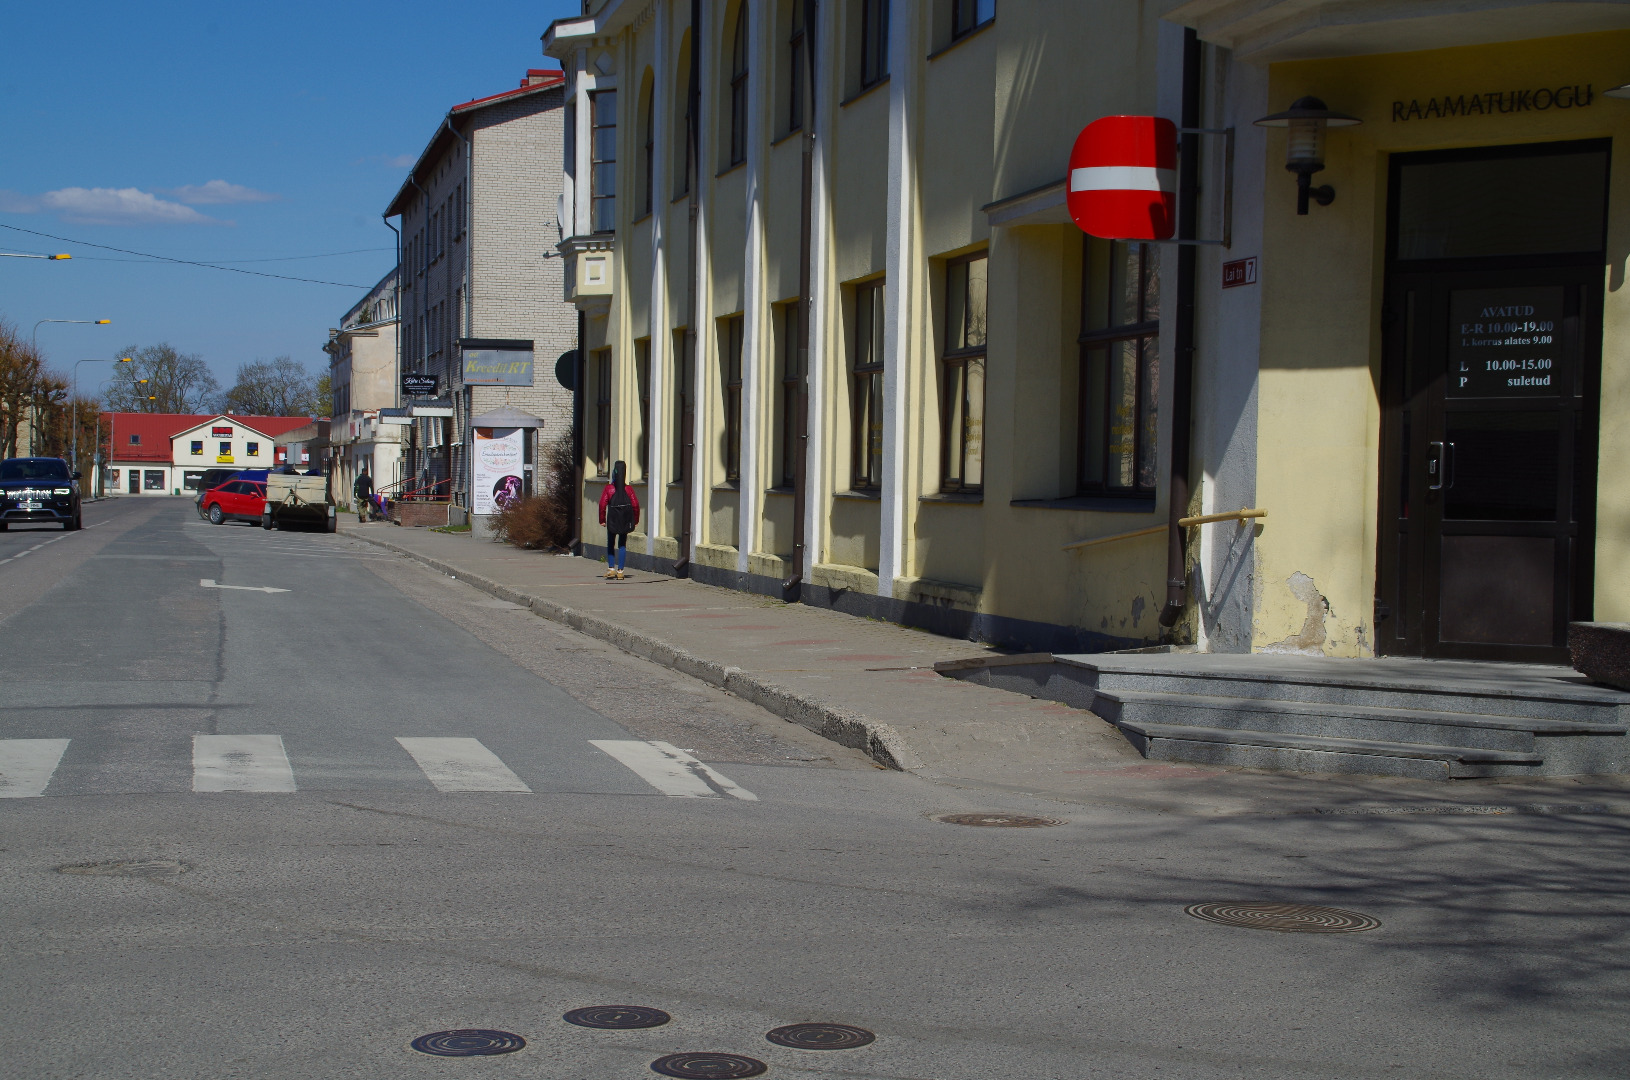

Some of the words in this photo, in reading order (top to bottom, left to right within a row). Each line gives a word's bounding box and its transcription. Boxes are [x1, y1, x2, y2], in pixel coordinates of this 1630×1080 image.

[1391, 84, 1594, 123] RAAMATUKOGU
[1225, 267, 1235, 282] Lai
[1236, 267, 1243, 280] tn
[1247, 261, 1254, 281] 7
[1480, 305, 1535, 318] AVATUD
[1461, 323, 1484, 335] E-R
[1487, 320, 1554, 334] 10.00-19.00
[1472, 338, 1502, 347] korrus
[1504, 336, 1531, 346] alates
[1532, 335, 1553, 345] 9.00
[1460, 361, 1469, 372] L
[1486, 358, 1552, 371] 10.00-15.00
[1459, 376, 1468, 388] P
[1507, 374, 1551, 387] suletud
